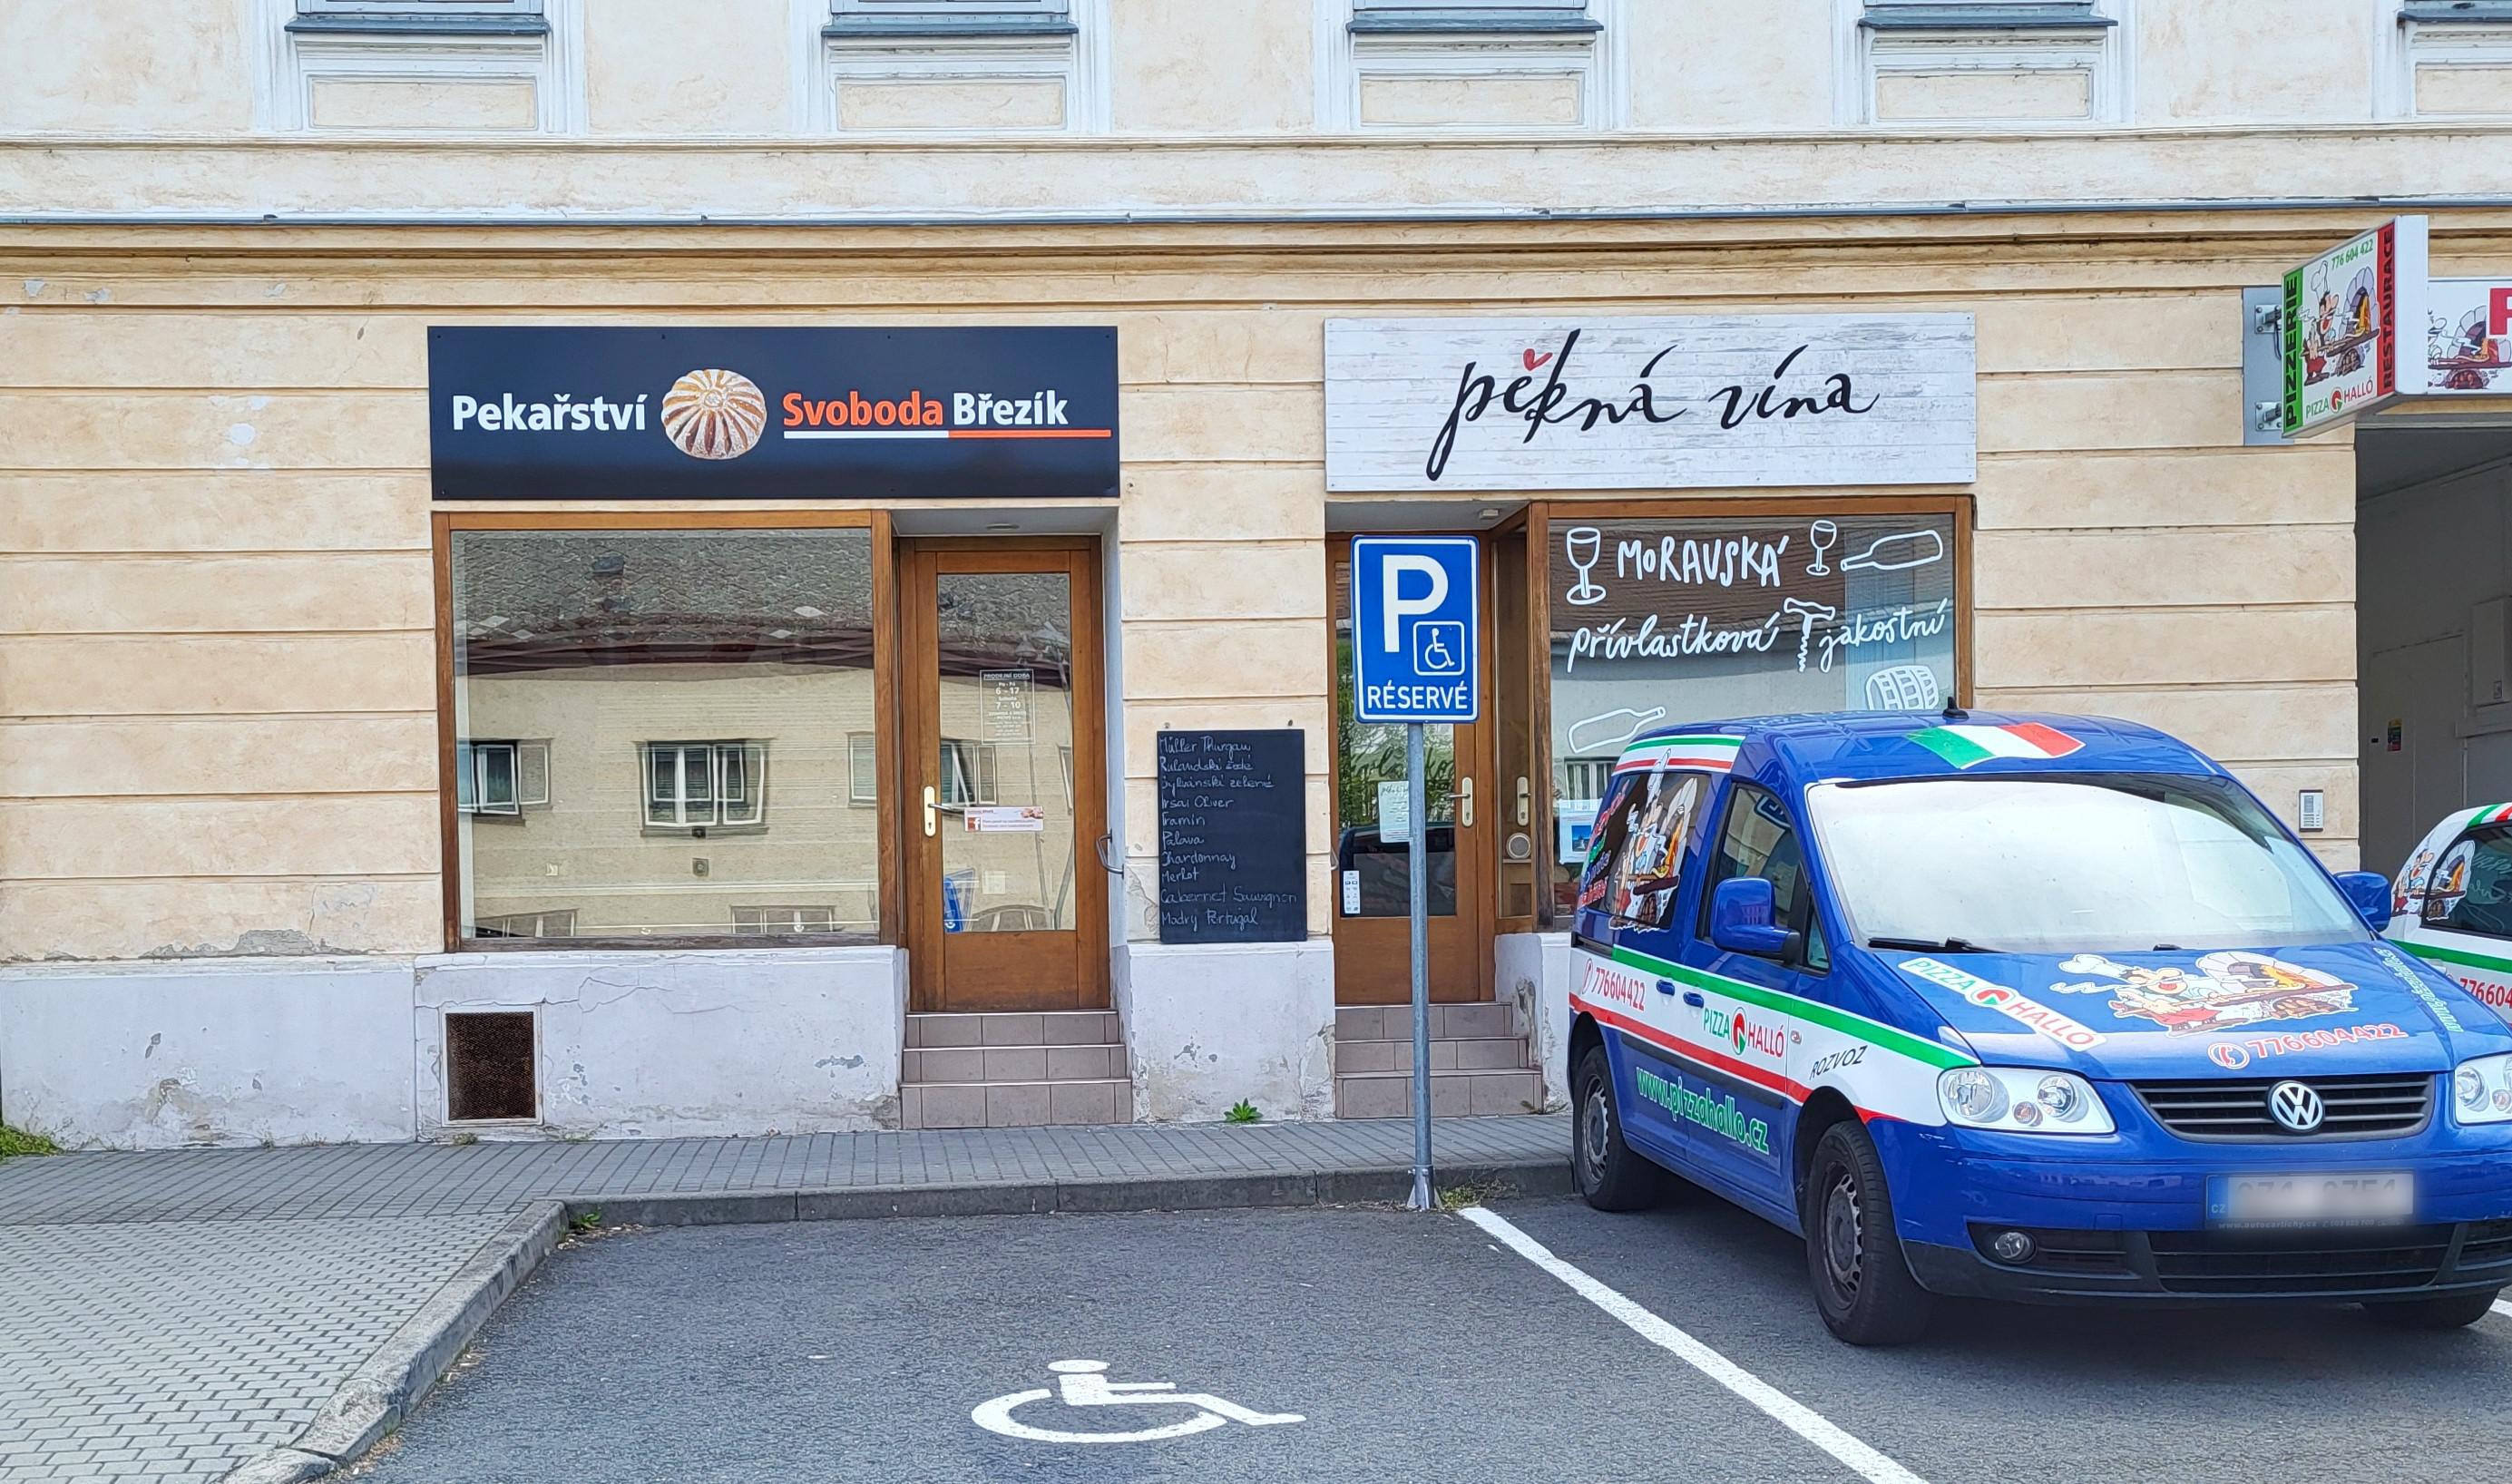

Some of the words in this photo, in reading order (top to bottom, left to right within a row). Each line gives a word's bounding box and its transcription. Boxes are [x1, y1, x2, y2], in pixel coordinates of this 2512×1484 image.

[2331, 254, 2344, 271] 776
[2345, 247, 2360, 263] 604
[2360, 238, 2374, 255] 422
[2383, 229, 2394, 389] RESTAURACE
[2285, 275, 2297, 427] PIZZERIE
[1707, 344, 1881, 430] vína
[2305, 399, 2330, 417] PIZZA
[2343, 376, 2374, 402] HALLÓ
[453, 393, 646, 431] Pekařství
[784, 391, 943, 426] Svoboda
[953, 390, 1070, 425] Březík
[1383, 554, 1449, 653] P
[1567, 610, 1781, 673] přívlastková
[1819, 597, 1949, 673] jakostní
[995, 687, 1002, 695] 6
[1009, 687, 1020, 695] 17
[996, 701, 1002, 710] 7
[1011, 701, 1021, 709] 10
[1367, 680, 1469, 710] RÉSERVÉ
[1194, 795, 1235, 808] Oliver
[1161, 851, 1236, 870] Chardonnay
[1161, 866, 1199, 884] Merlot
[1160, 884, 1227, 903] Cabernet
[1592, 966, 1646, 1011] 776604422
[1908, 960, 1977, 991] PIZZA
[1703, 1007, 1731, 1037] PIZZA
[1747, 1021, 1785, 1059] HALLÓ
[2247, 1023, 2409, 1059] 776604422
[1809, 1045, 1868, 1081] ROZVOZ
[1636, 1066, 1770, 1156] www.pizzahallo.cz
[2211, 1204, 2226, 1214] CZ
